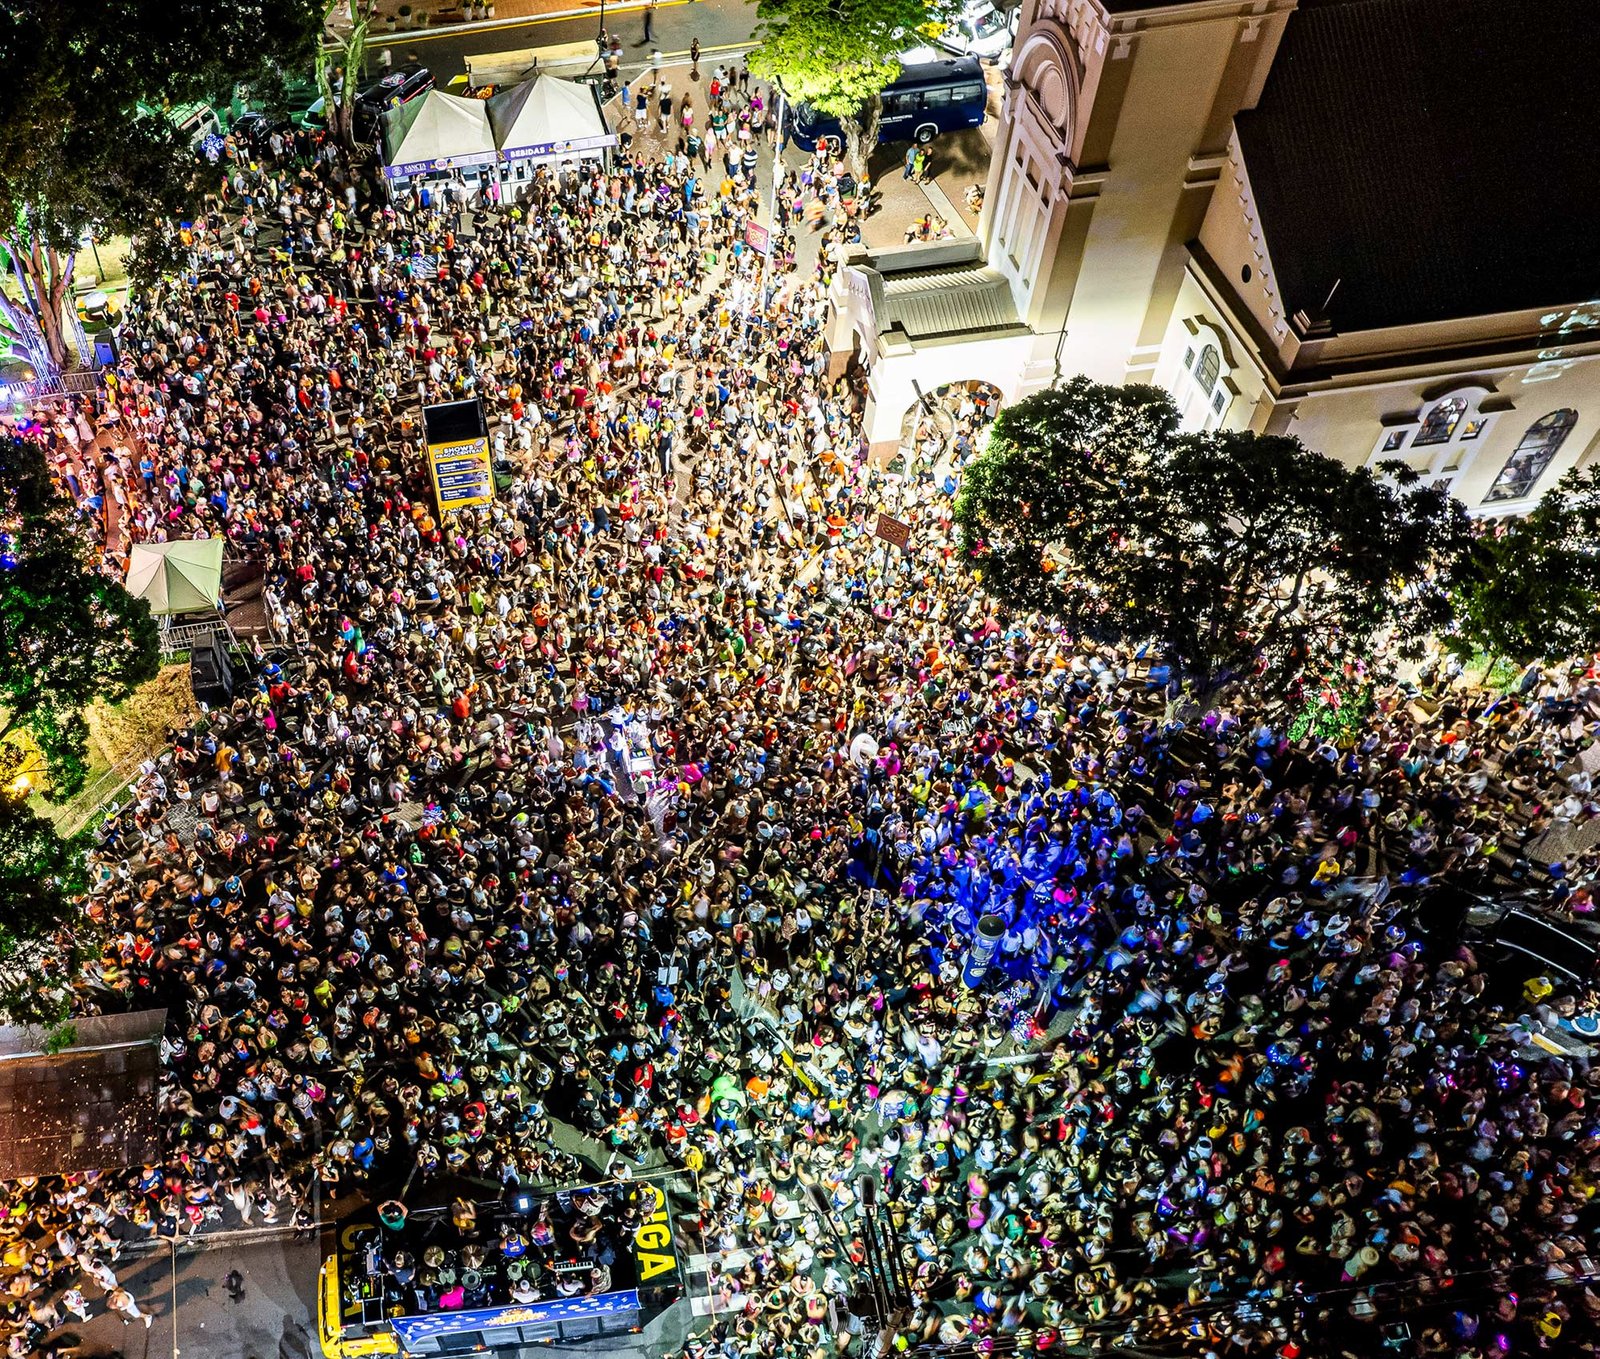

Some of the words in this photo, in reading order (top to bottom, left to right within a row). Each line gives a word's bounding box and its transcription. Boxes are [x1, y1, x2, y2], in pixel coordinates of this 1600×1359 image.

[510, 146, 546, 158] BEBIDAS
[404, 163, 427, 172] SANCTA
[443, 445, 474, 454] SHOWS
[456, 448, 484, 456] CENTRAL
